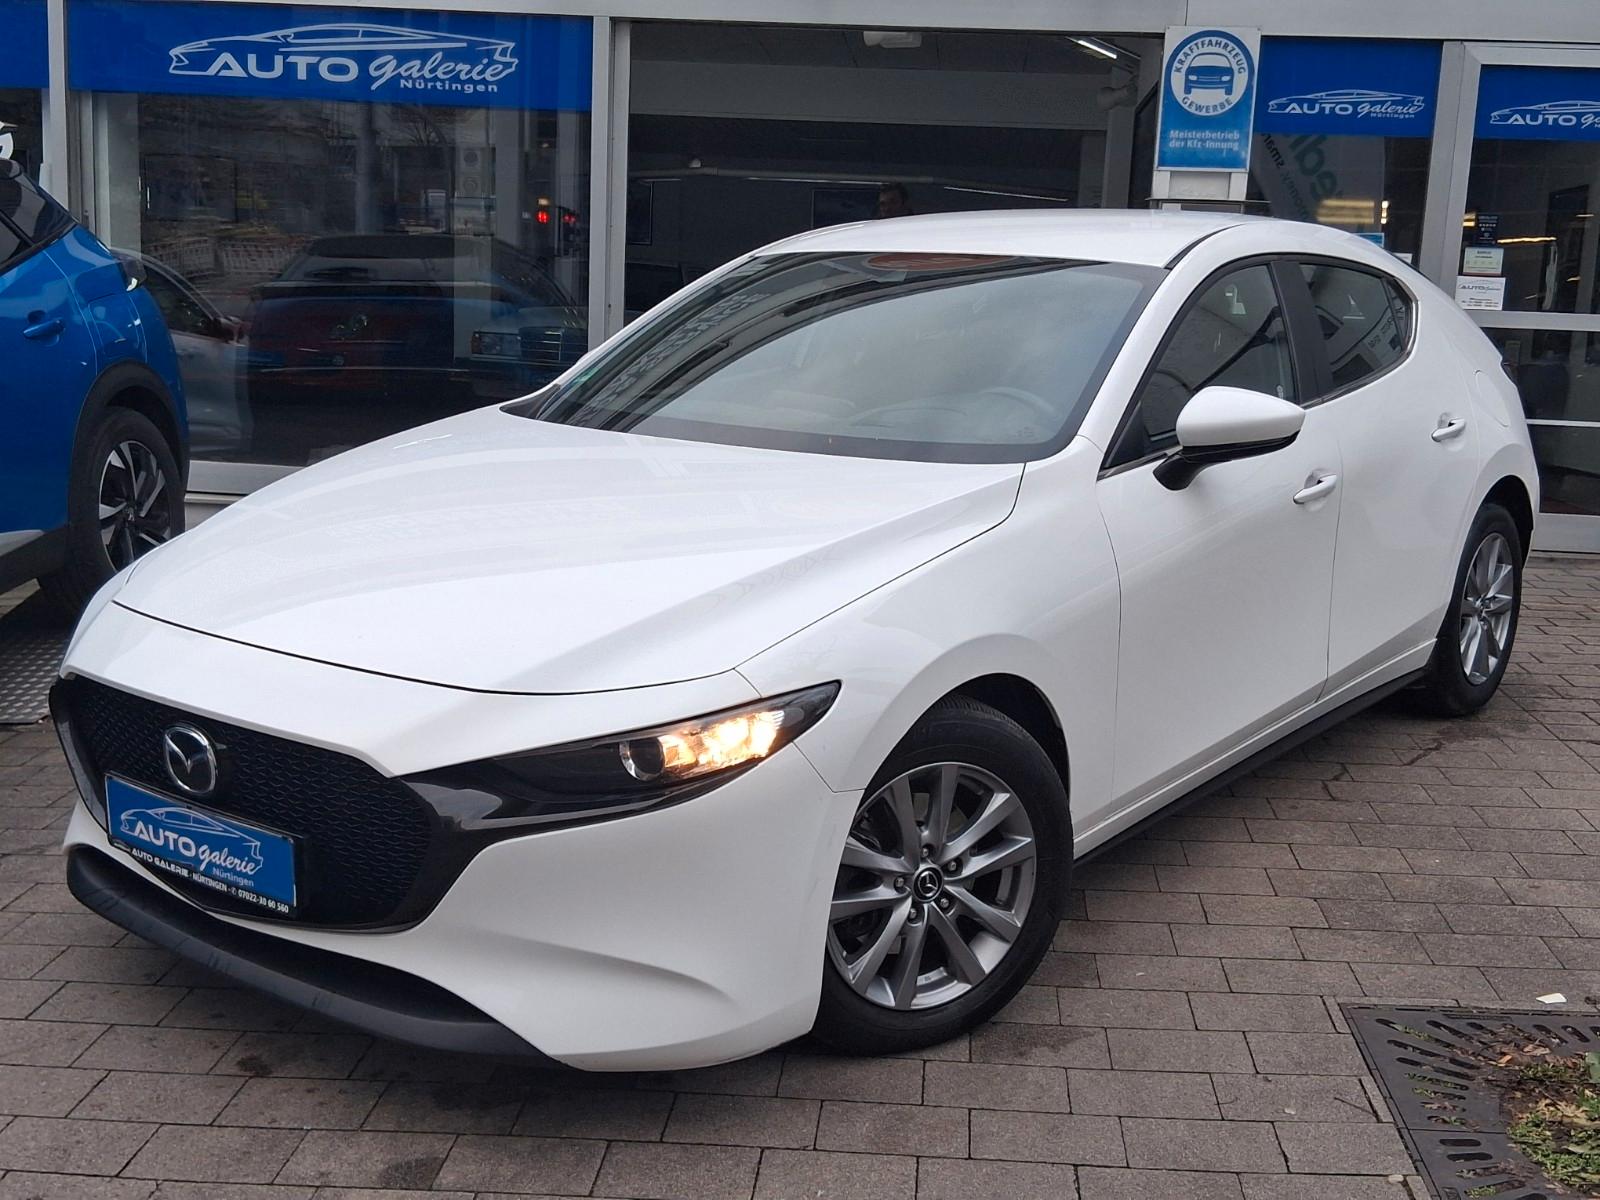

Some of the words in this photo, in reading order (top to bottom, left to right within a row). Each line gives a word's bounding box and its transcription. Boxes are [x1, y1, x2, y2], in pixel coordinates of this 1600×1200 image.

[1173, 39, 1246, 74] KRAFTFAHRZEUG
[208, 52, 358, 82] AUTO
[369, 51, 509, 91] galerie
[400, 79, 499, 93] Nürtingen
[1181, 96, 1233, 113] GEWERBE
[1285, 102, 1353, 115] AUTO
[1357, 101, 1419, 118] galerie
[1508, 114, 1577, 126] AUTO
[1169, 129, 1240, 139] Meisterbetrieb
[1169, 139, 1184, 148] der
[1187, 140, 1239, 151] Kfz-Innung
[133, 820, 196, 857] AUTO
[199, 843, 256, 875] galerie
[131, 847, 154, 863] AUTO
[154, 856, 189, 878] GALERIE
[192, 871, 228, 892] NÜRTINGEN
[212, 866, 254, 888] Nürtingen
